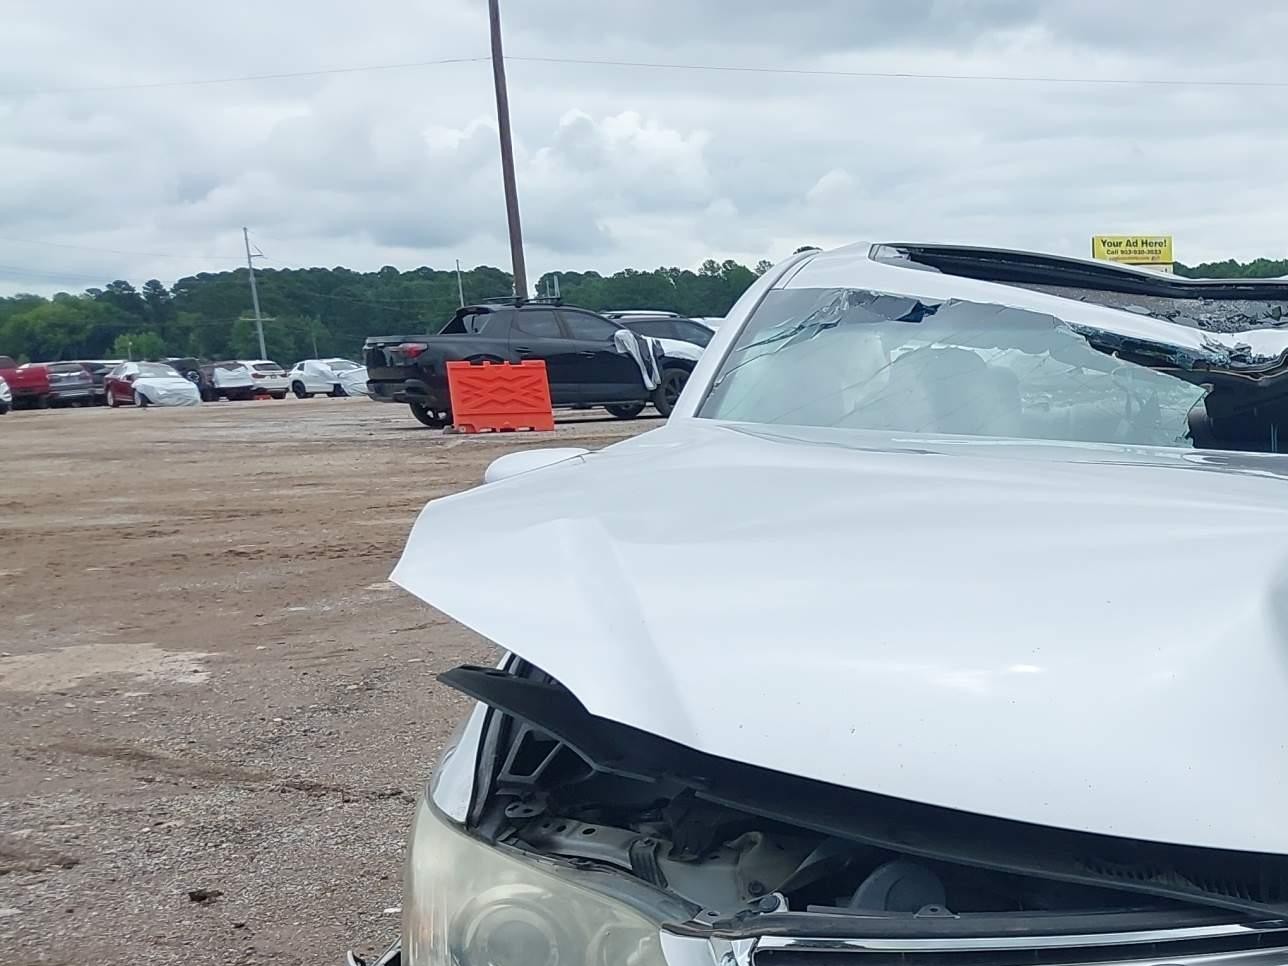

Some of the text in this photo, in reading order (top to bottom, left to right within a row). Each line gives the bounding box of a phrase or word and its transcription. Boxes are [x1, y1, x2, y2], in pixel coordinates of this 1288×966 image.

[1101, 239, 1167, 248] Your Ad Here!
